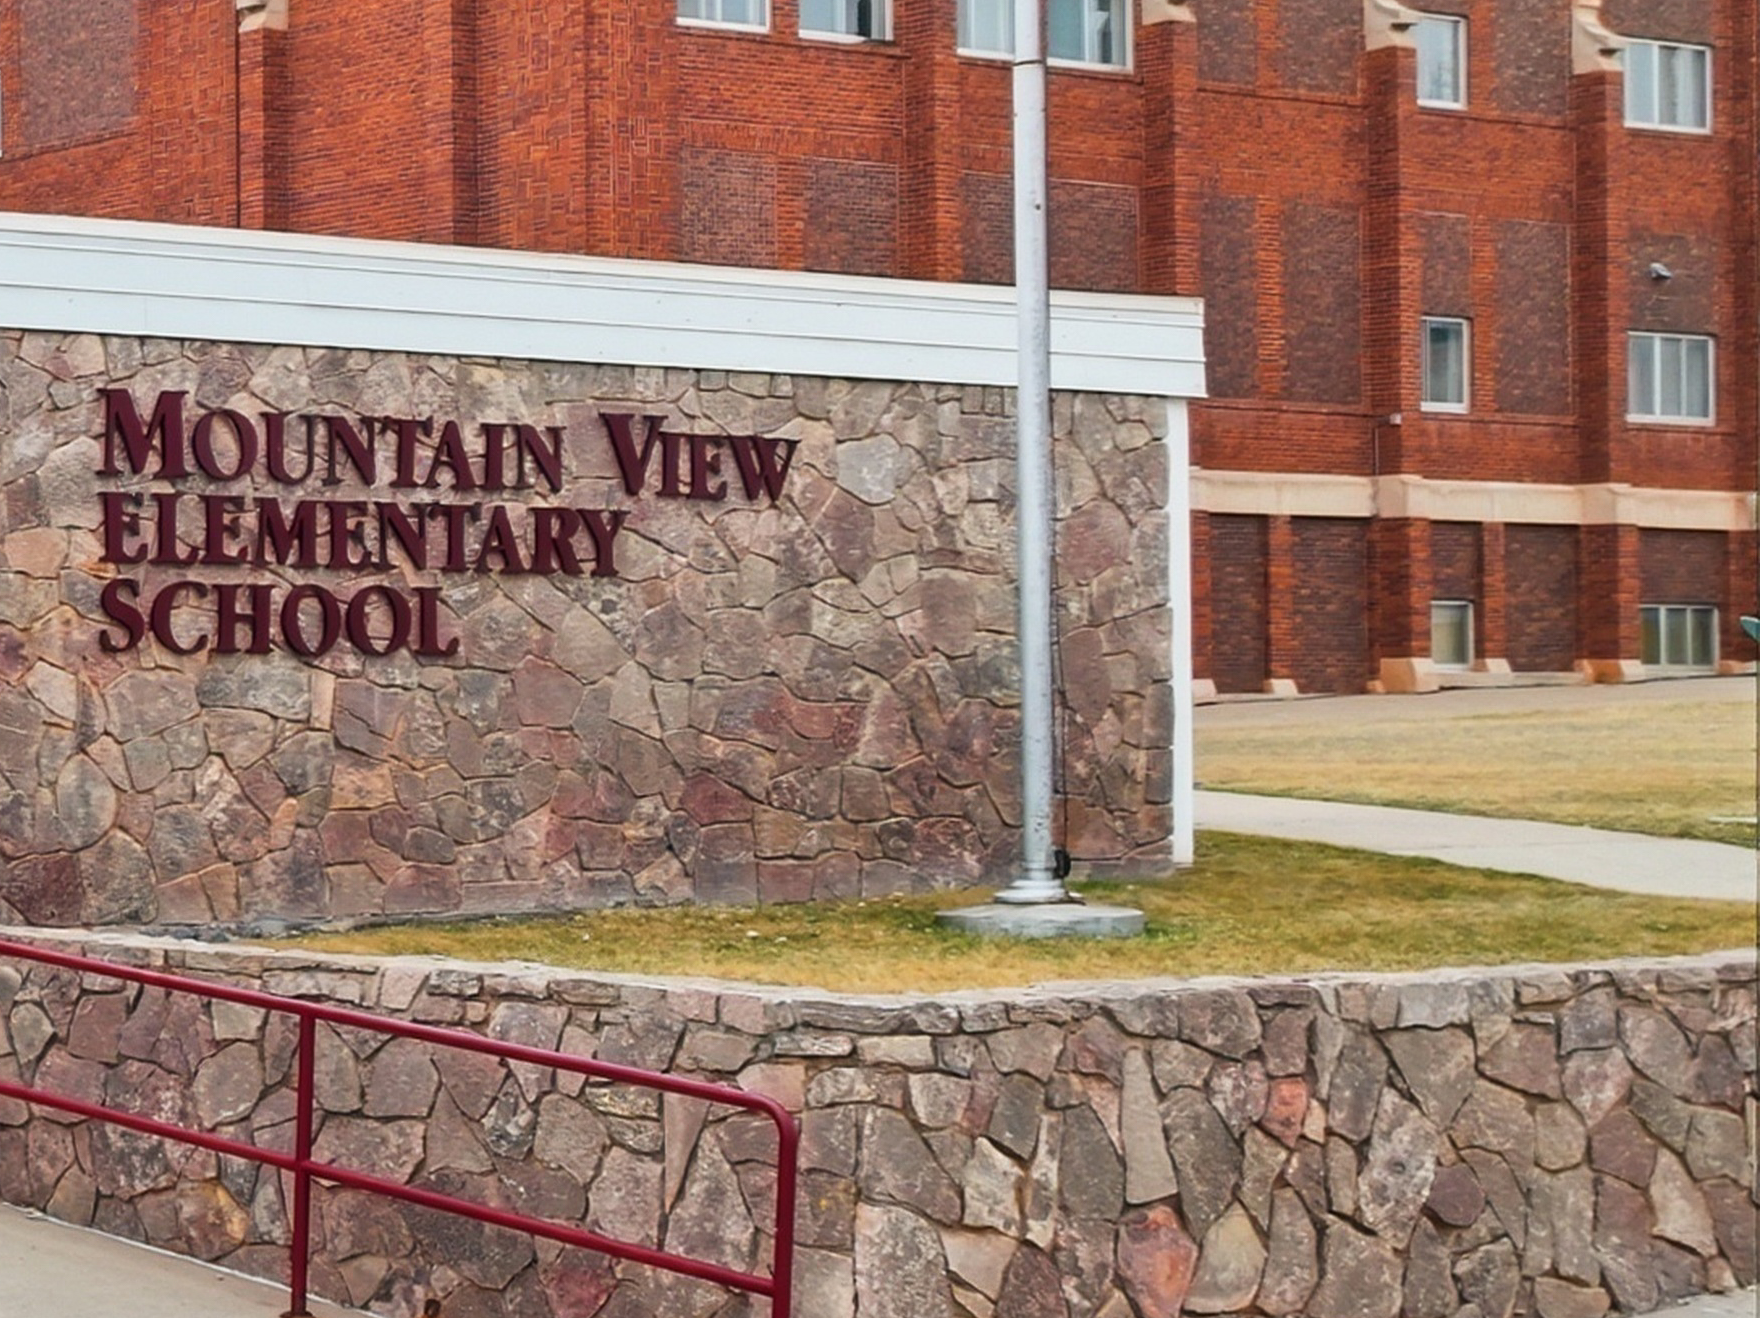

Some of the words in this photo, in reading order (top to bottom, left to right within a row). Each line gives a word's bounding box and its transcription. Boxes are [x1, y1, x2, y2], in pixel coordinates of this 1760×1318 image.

[96, 388, 567, 493] MOUNTAIN
[598, 412, 803, 504] VIEW
[97, 492, 632, 578] ELEMENTARY
[98, 579, 460, 657] SCHOOL
